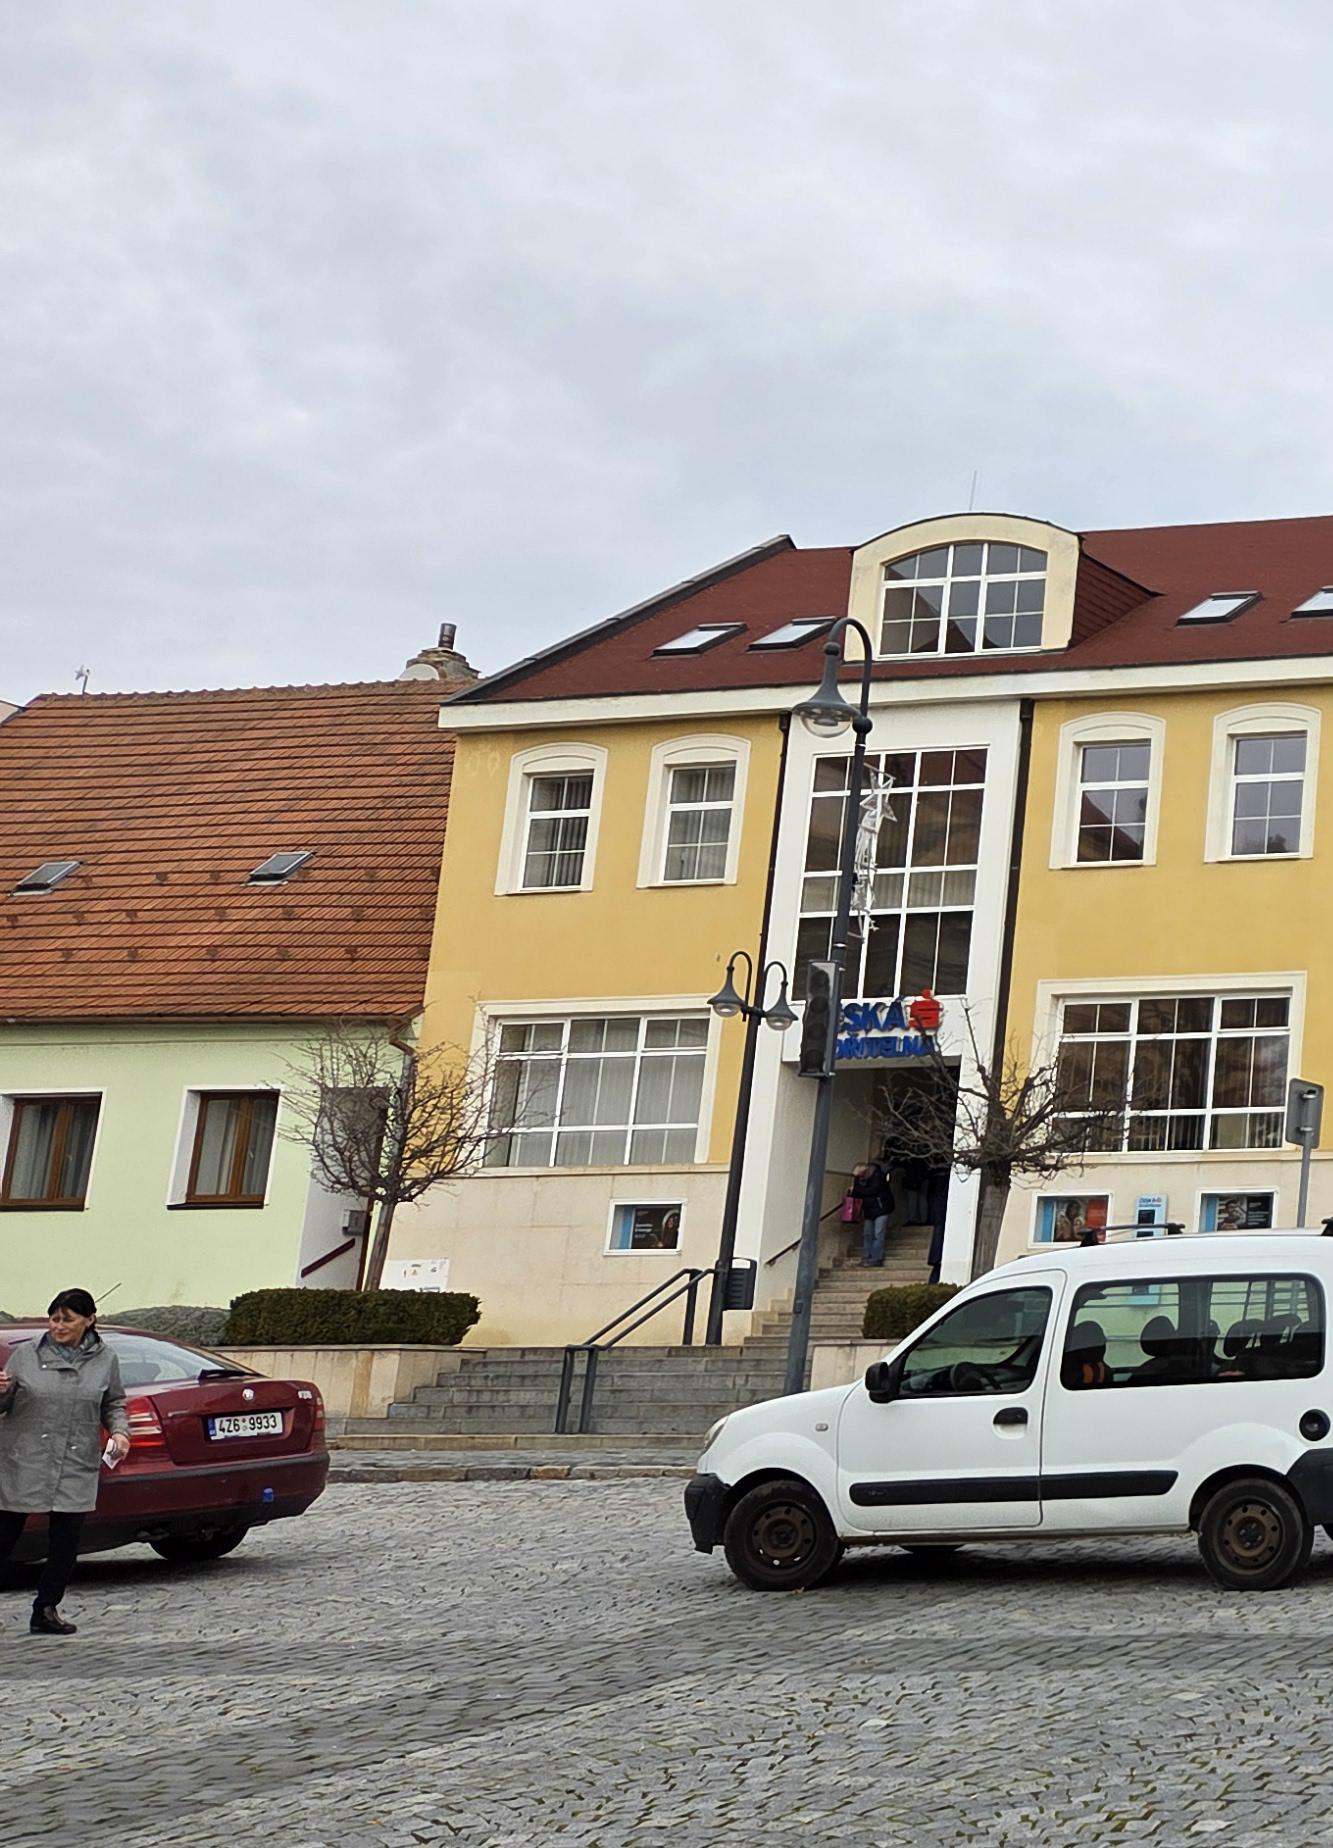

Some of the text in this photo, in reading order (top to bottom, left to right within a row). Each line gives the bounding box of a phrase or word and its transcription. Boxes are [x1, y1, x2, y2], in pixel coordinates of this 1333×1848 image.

[838, 996, 906, 1031] SKÁ
[218, 1418, 241, 1434] 4Z6
[248, 1414, 278, 1431] 9933
